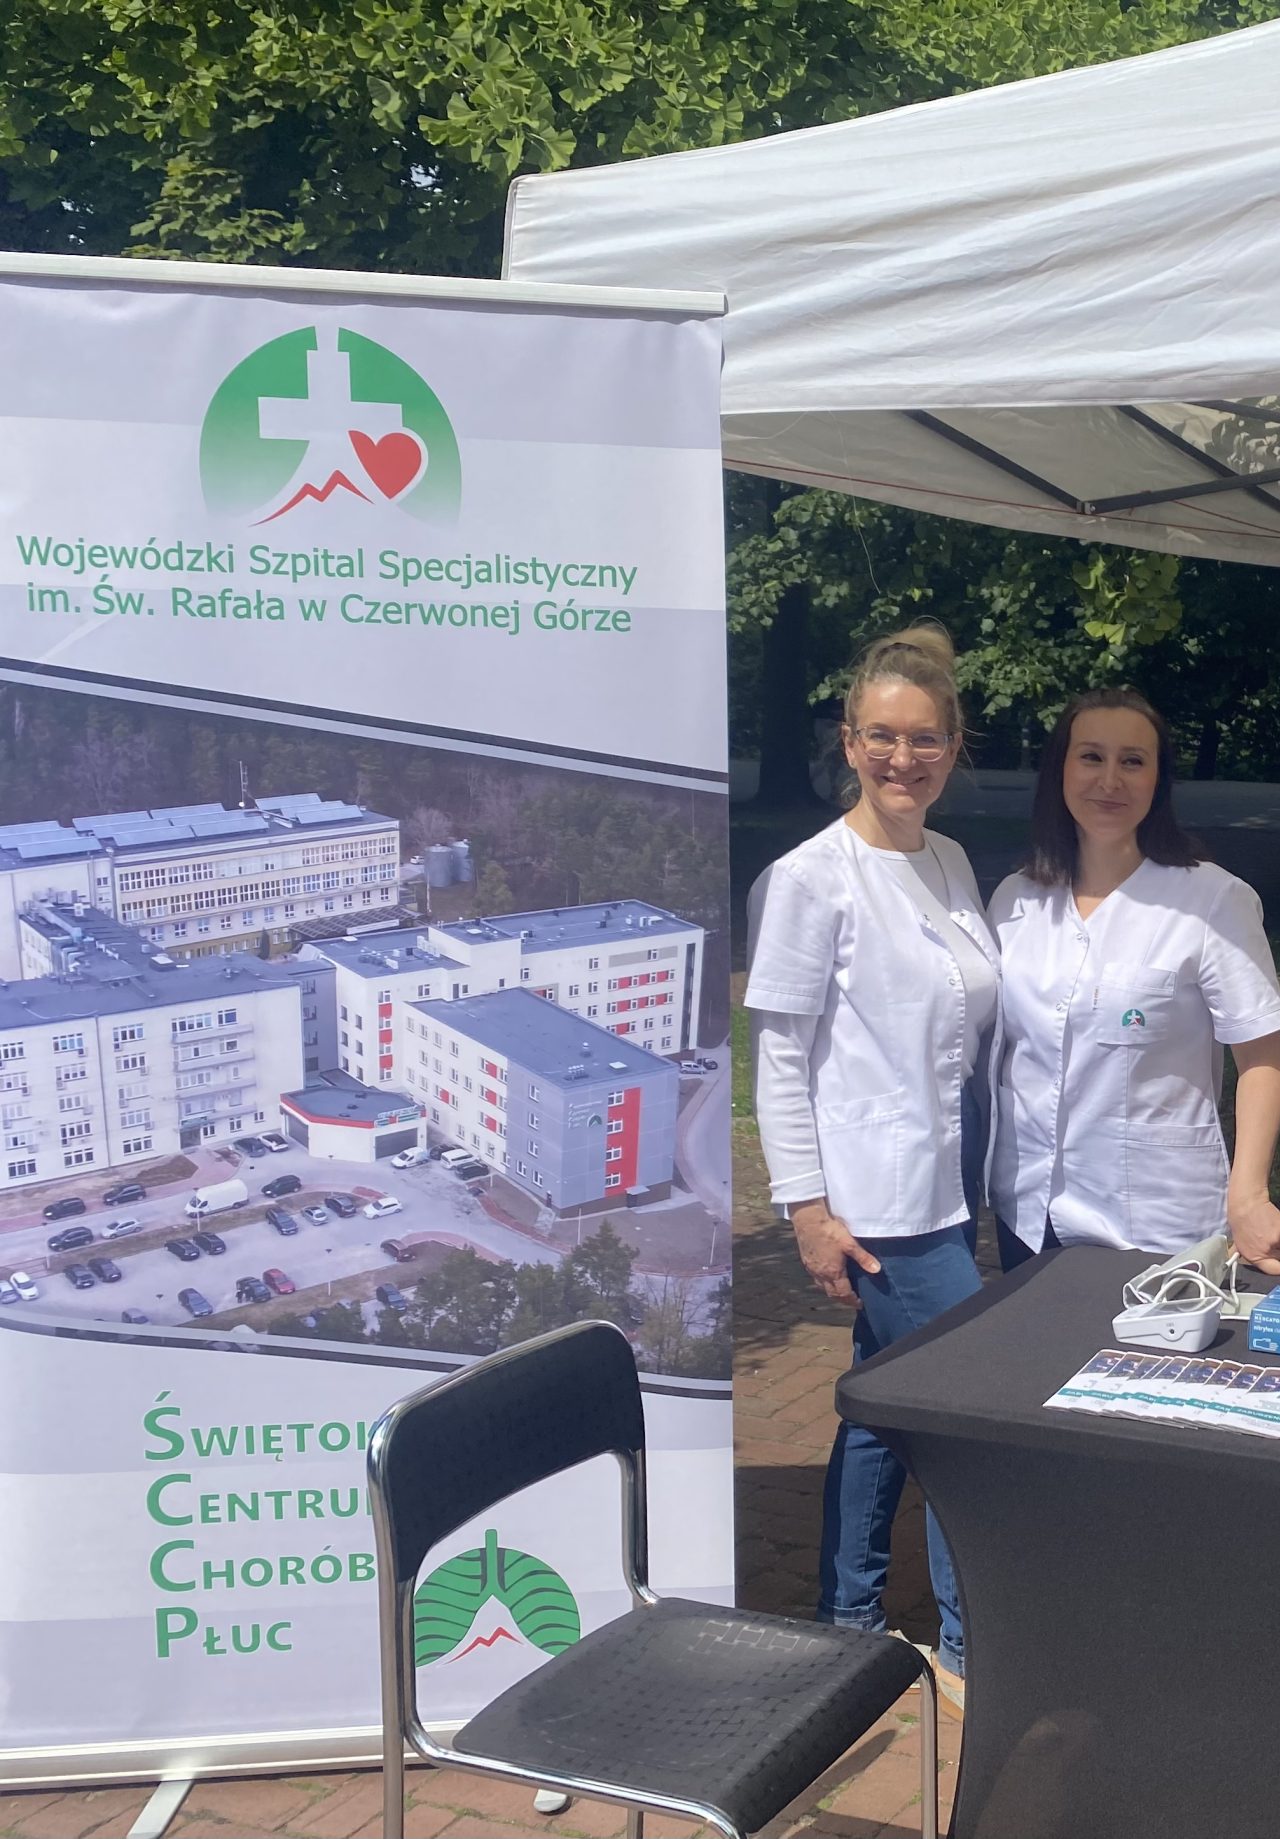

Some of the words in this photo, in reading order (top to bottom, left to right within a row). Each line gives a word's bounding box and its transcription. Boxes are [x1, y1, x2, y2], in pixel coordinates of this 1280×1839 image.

[16, 535, 234, 575] Wojewódzki
[249, 544, 364, 583] Szpital
[378, 549, 638, 595] Specjalistyczny
[27, 582, 81, 614] im.
[93, 574, 154, 616] Św.
[171, 587, 284, 620] Rafała
[298, 597, 327, 621] w
[340, 593, 520, 635] Czerwonej
[533, 599, 632, 632] Górze
[143, 1391, 378, 1462] ŚWIĘTOK
[145, 1473, 373, 1527] CENTRU
[148, 1539, 376, 1594] CHORÓB
[154, 1605, 293, 1659] PŁUC
